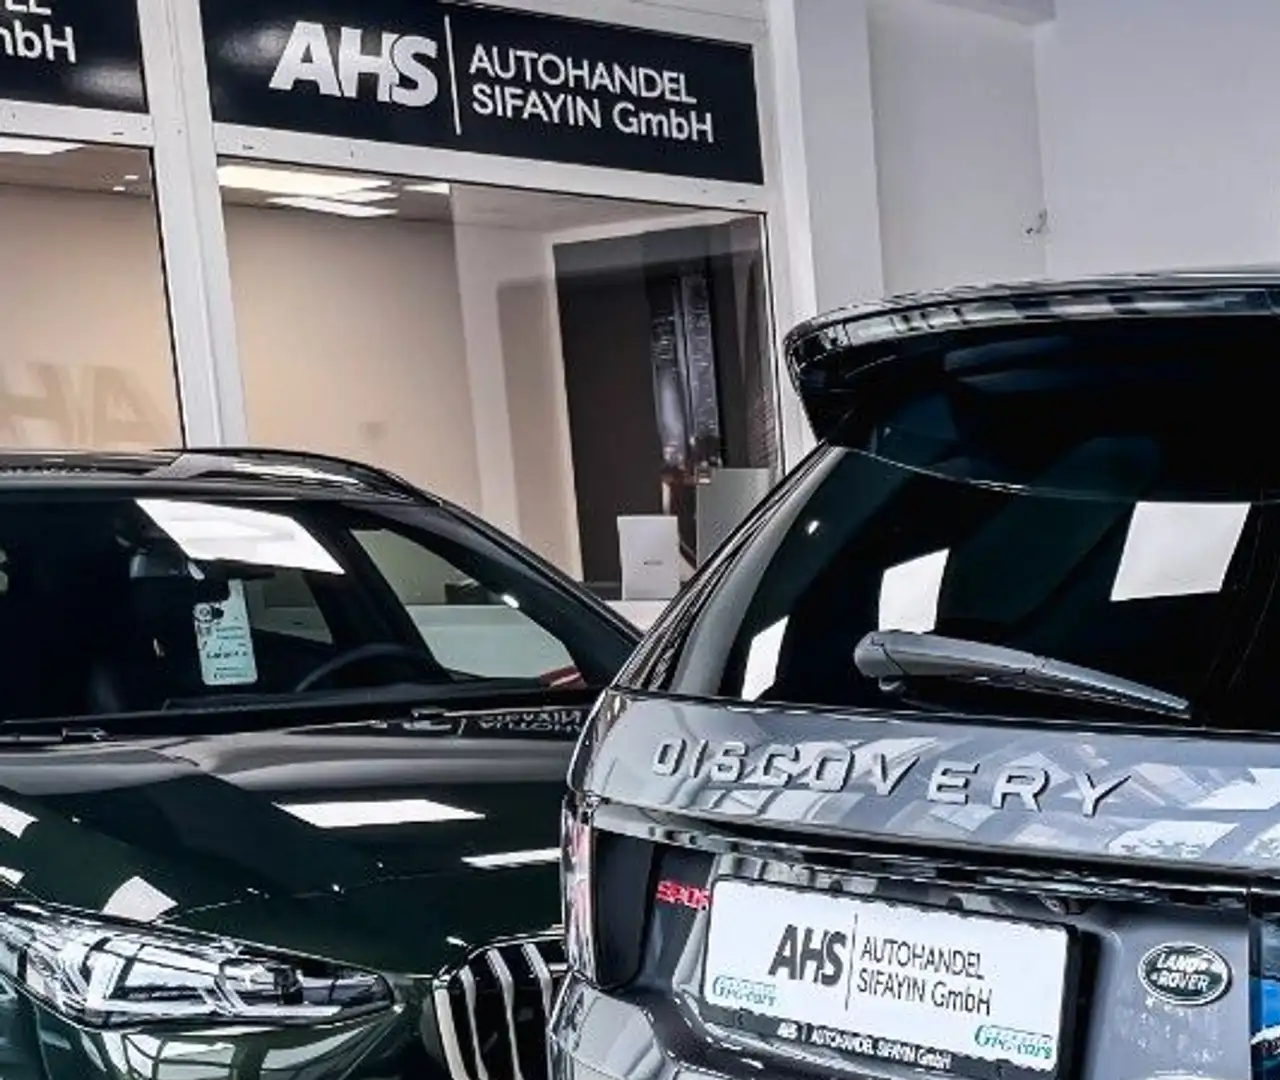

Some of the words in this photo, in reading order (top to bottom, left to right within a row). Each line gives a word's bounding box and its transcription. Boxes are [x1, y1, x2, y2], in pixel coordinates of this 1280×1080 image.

[268, 20, 439, 107] AHS
[469, 43, 698, 104] AUTOHANDEL
[472, 84, 601, 129] SIFAYIN
[611, 103, 715, 144] GmbH
[652, 738, 1131, 818] DISCOVERY
[767, 923, 848, 987] AHS
[860, 935, 985, 981] AUTOHANDEL
[1156, 952, 1201, 973] LAND
[1156, 969, 1211, 993] ROVER
[856, 967, 926, 1003] SIFAYIN
[930, 980, 993, 1017] GmbH
[916, 1048, 952, 1070] GmbH
